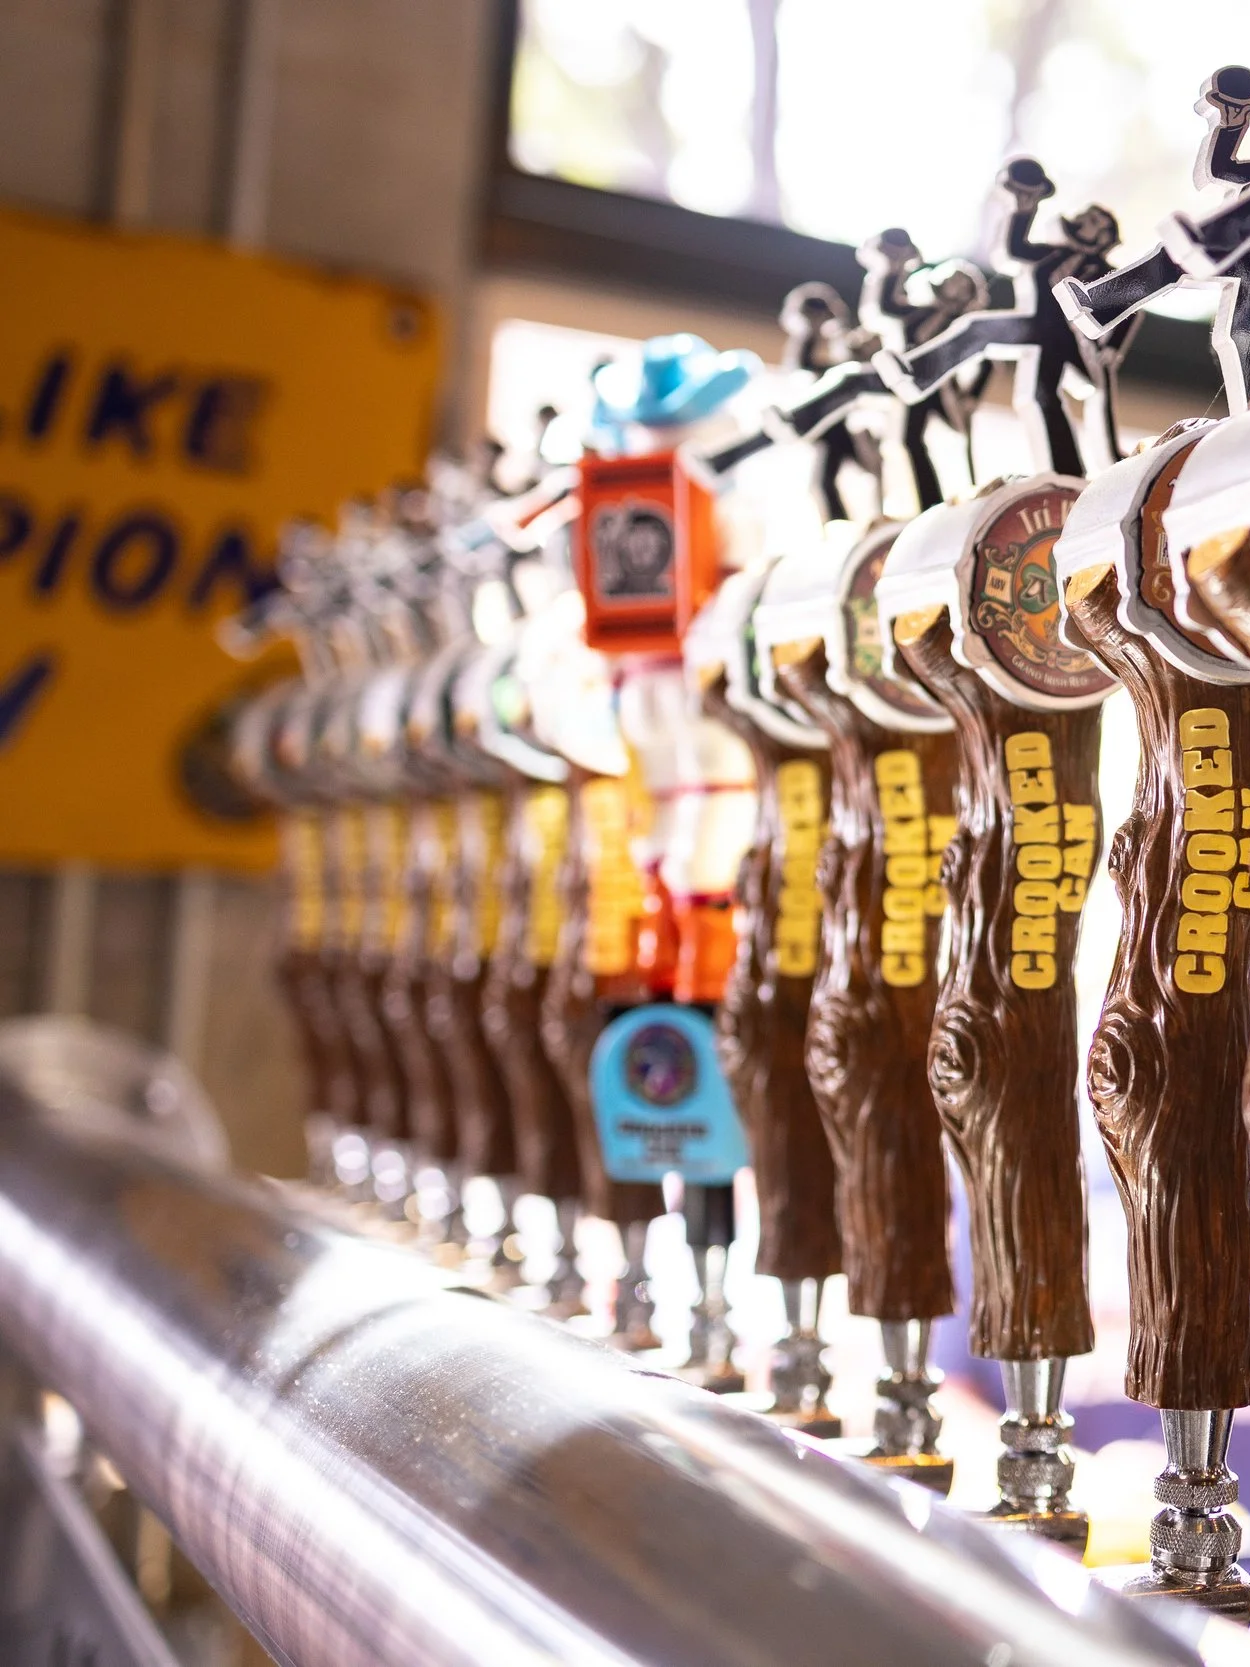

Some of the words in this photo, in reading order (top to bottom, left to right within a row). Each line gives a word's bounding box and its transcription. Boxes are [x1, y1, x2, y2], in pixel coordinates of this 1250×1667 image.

[0, 345, 272, 482] IKE
[1012, 655, 1042, 681] GRAND
[1043, 673, 1068, 687] IRISH
[1069, 676, 1089, 688] RED
[875, 750, 928, 986] CROOKED
[1005, 732, 1063, 989] CROOKED
[1056, 803, 1096, 912] CAN
[1174, 708, 1238, 993] CROOKED
